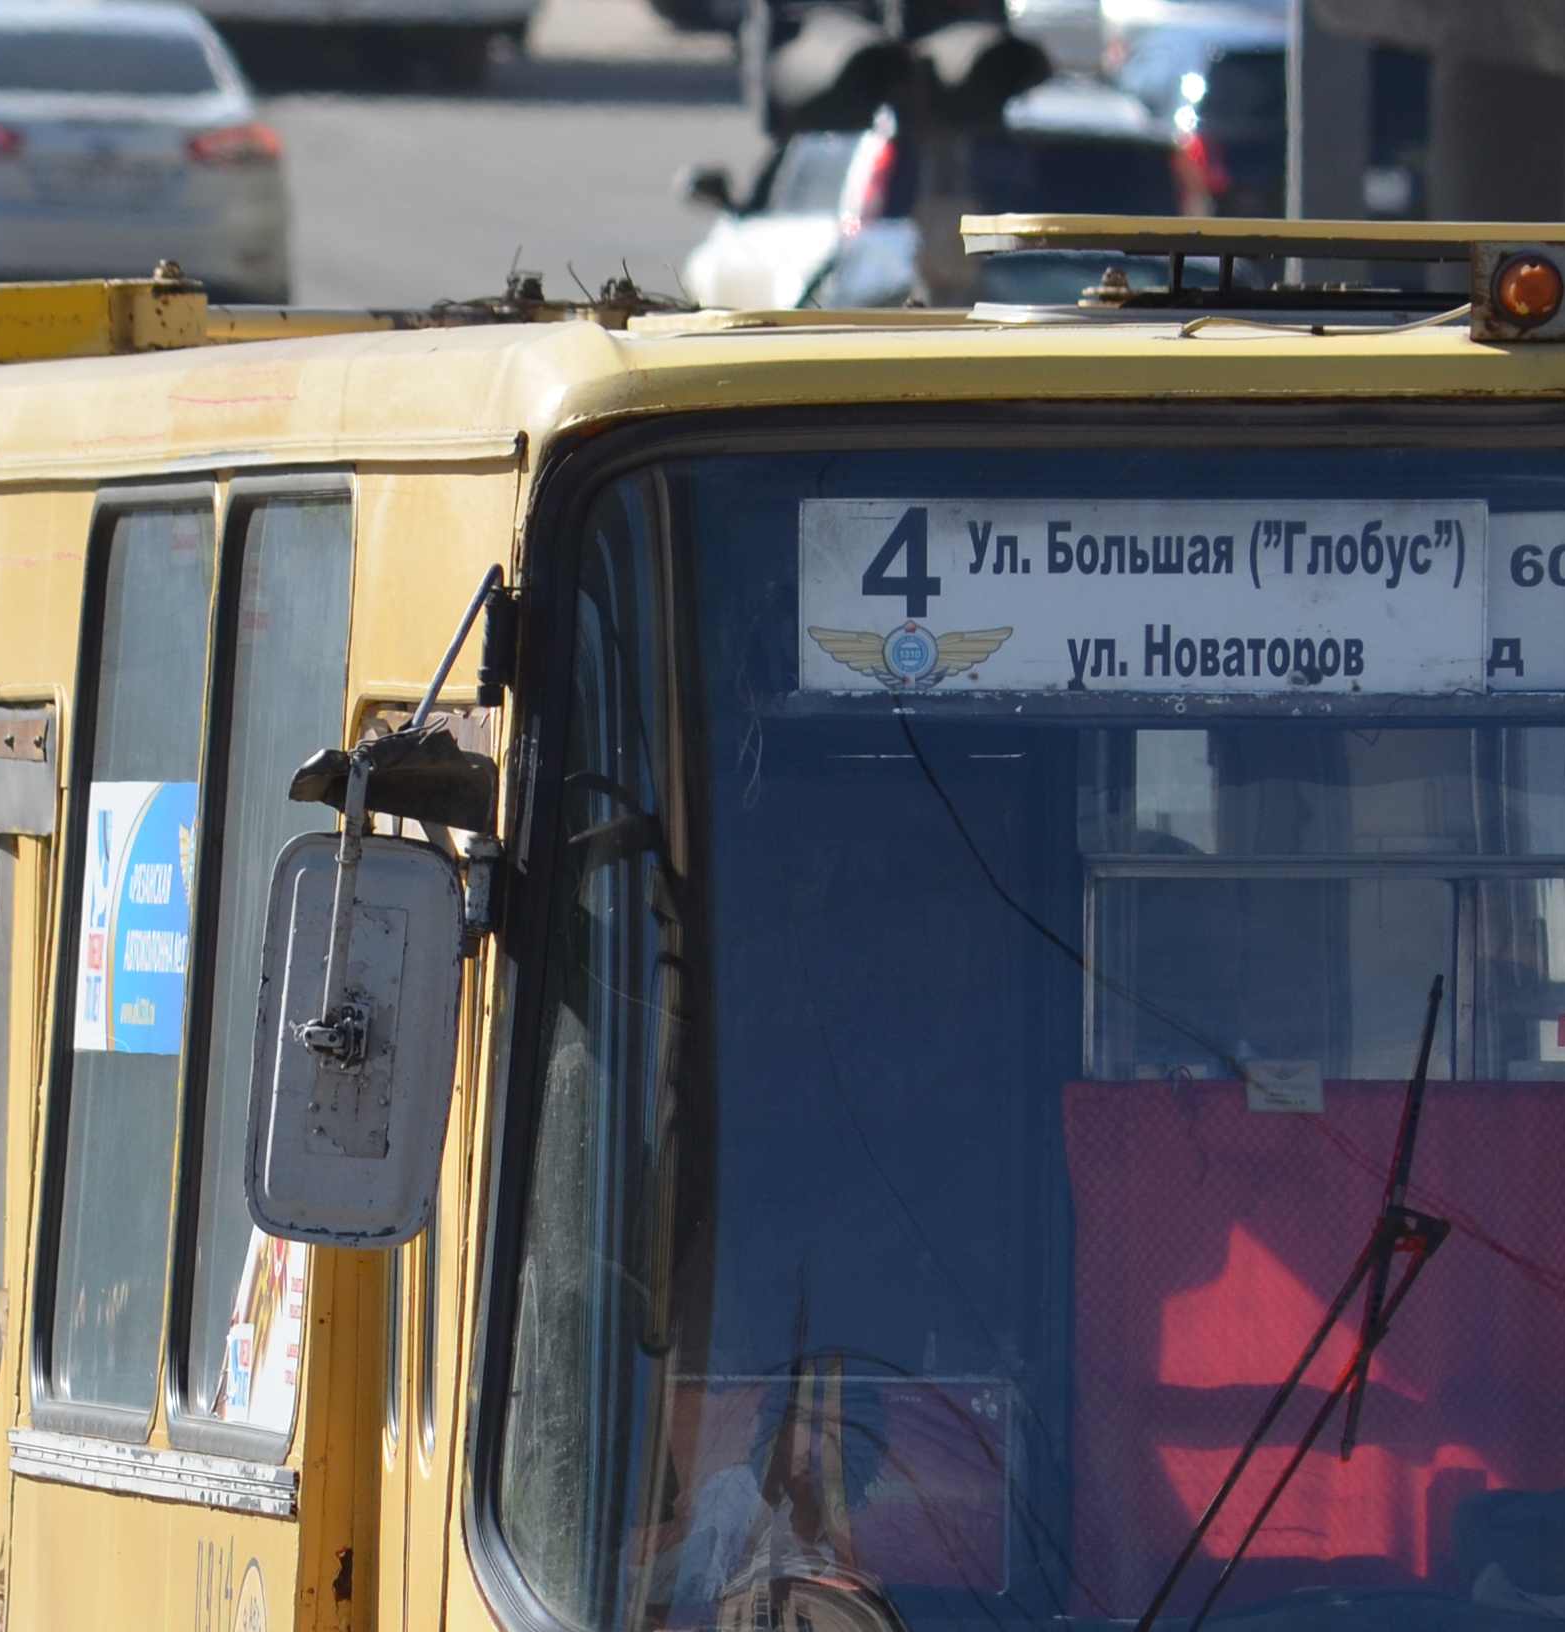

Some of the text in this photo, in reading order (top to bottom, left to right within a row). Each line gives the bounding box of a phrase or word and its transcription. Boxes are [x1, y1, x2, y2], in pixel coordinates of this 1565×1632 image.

[862, 506, 942, 618] 4
[967, 519, 1031, 575] Ул.
[1047, 520, 1234, 576] Большая
[1067, 623, 1365, 691] ул. Новаторов
